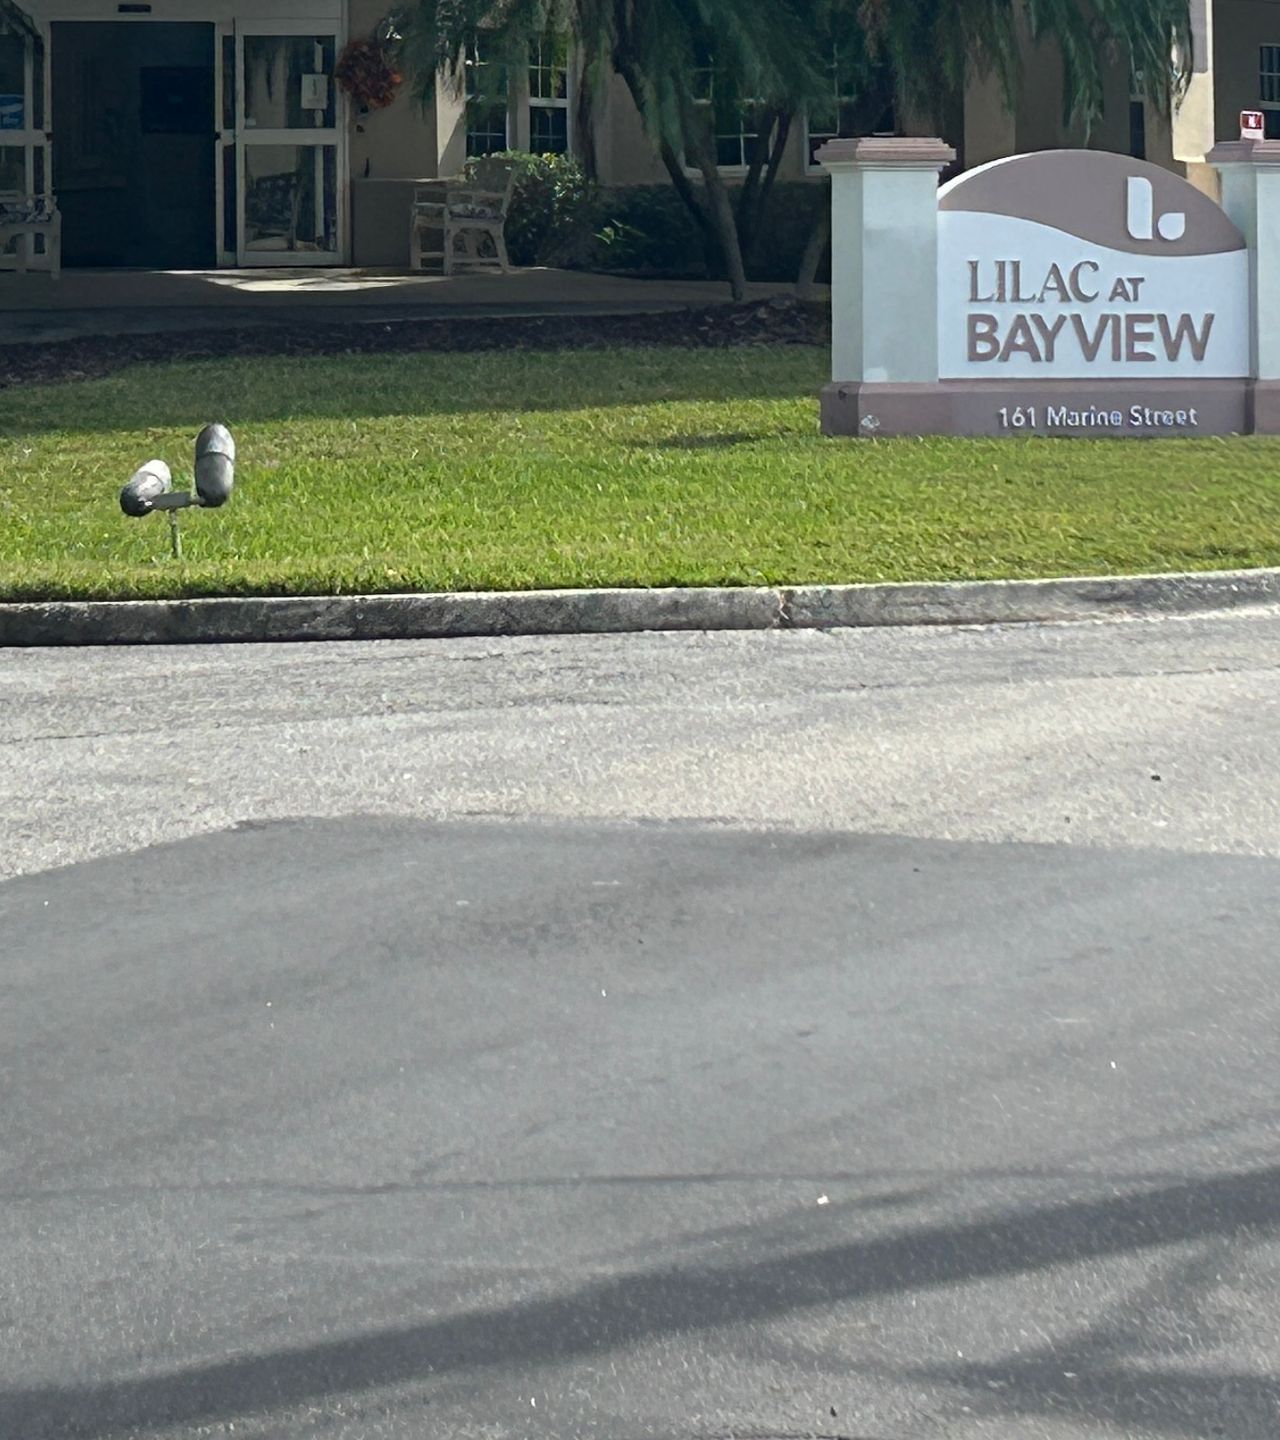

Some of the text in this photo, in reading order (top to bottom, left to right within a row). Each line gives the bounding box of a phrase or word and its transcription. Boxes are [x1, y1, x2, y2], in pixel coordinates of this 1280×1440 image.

[967, 259, 1145, 303] LILAC AT
[966, 312, 1216, 363] BAYVIEW
[999, 405, 1199, 428] 161 Marine Street
